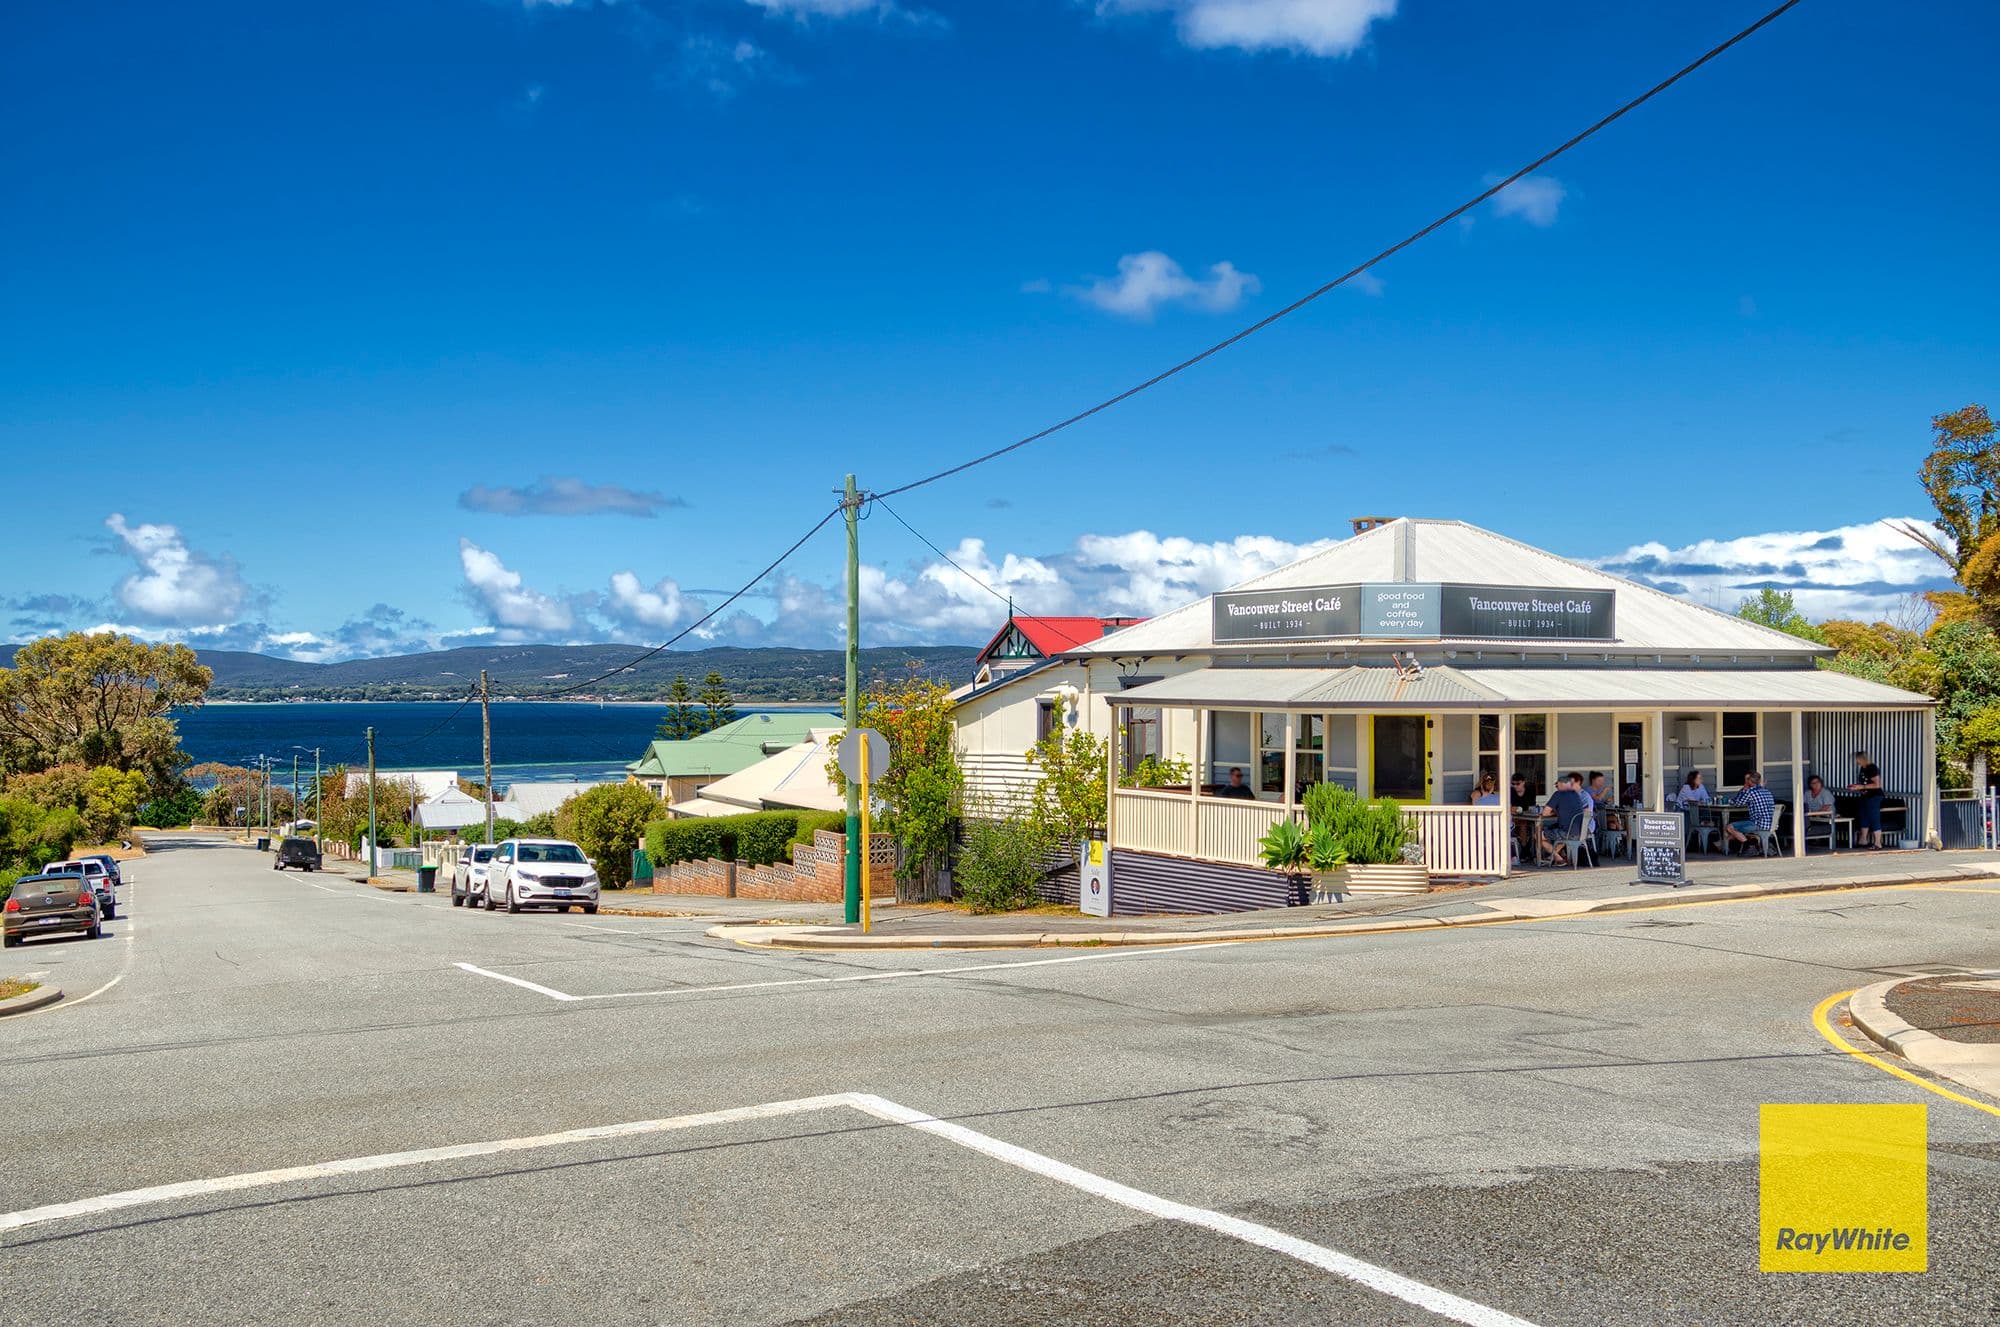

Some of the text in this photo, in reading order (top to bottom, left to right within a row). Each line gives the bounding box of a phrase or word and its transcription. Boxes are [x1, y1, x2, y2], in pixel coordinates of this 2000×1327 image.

[1378, 592, 1424, 602] good food
[1227, 597, 1342, 616] Vancouver Street Café
[1468, 596, 1592, 614] Vancouver Street Café
[1386, 610, 1417, 618] coffee
[1260, 620, 1303, 629] BUILT 1934
[1380, 620, 1424, 628] every day
[1508, 619, 1554, 628] BUILT 1934
